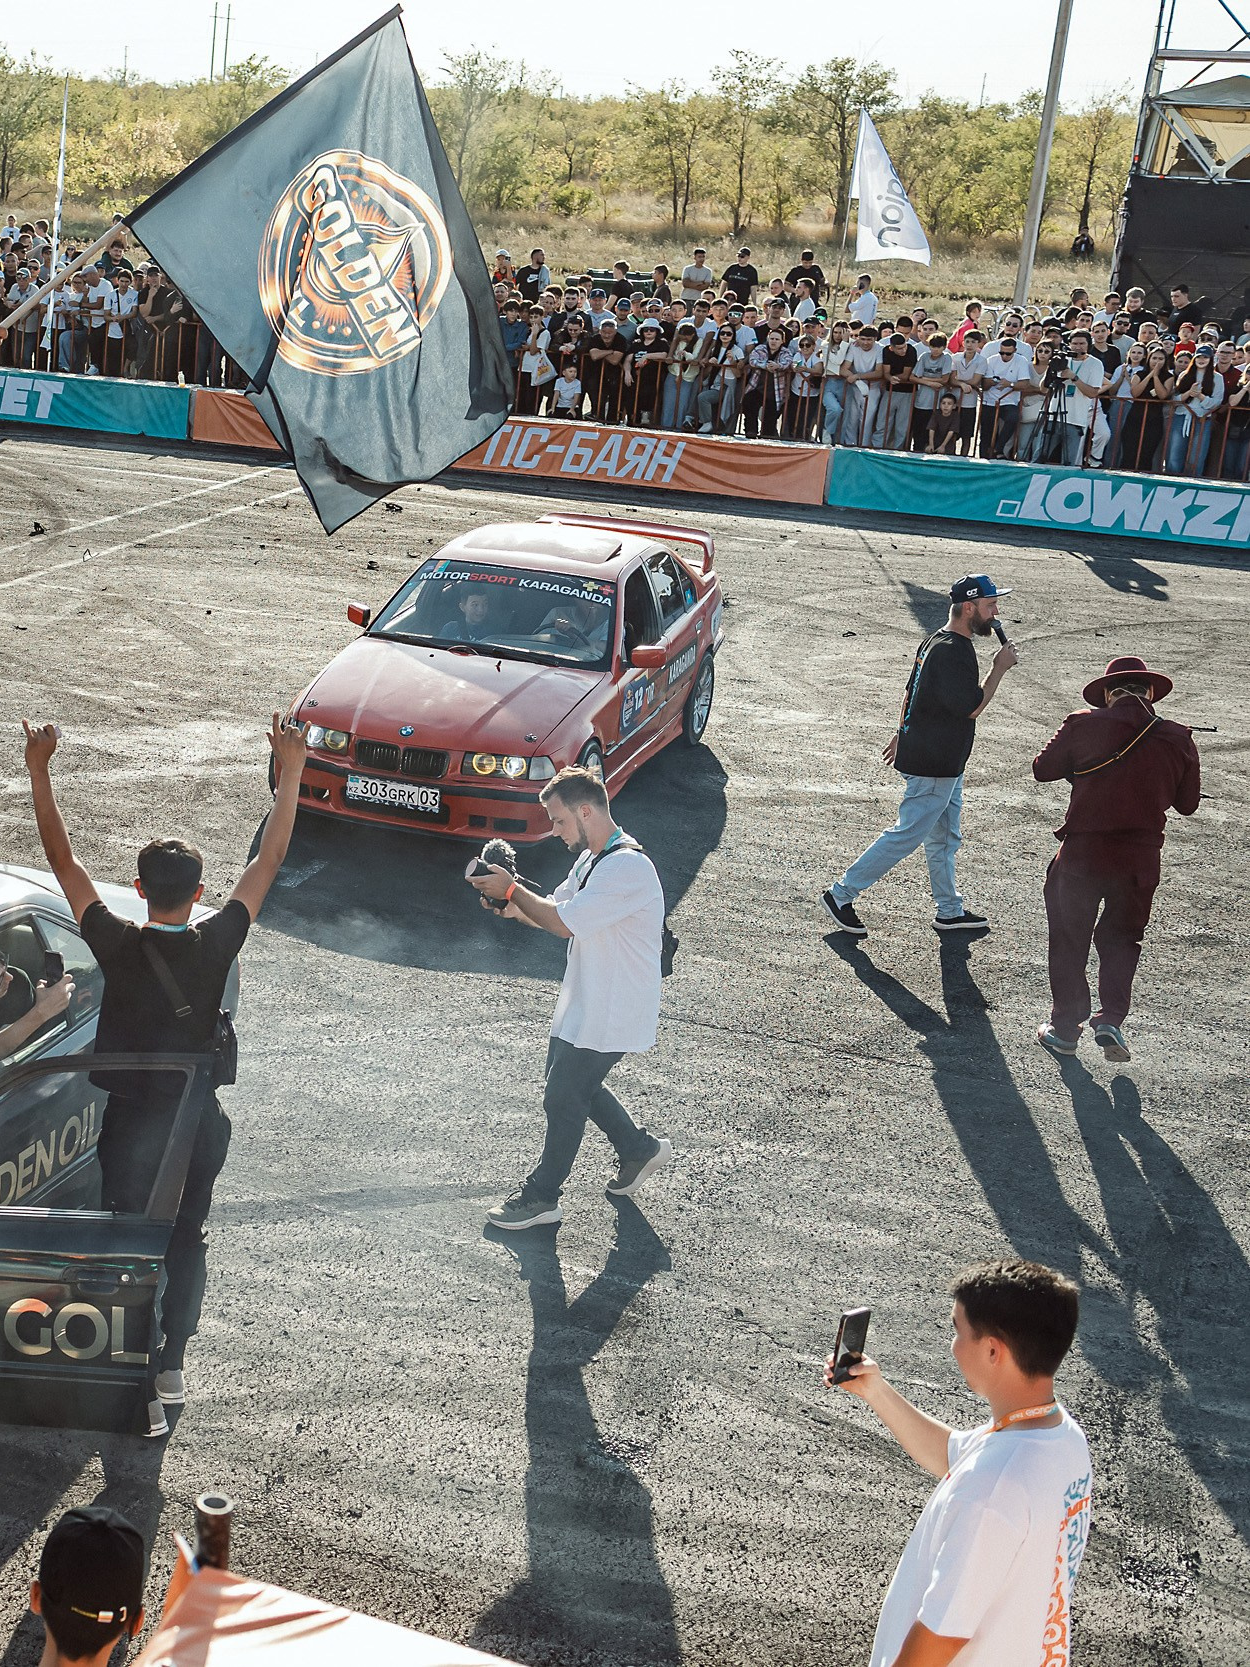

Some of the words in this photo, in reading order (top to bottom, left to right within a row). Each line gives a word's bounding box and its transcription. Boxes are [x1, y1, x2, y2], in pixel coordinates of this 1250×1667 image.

[301, 166, 420, 356] GOLDEN
[518, 578, 613, 607] KARAGANDA
[348, 786, 359, 794] KZ
[420, 790, 439, 807] 03
[3, 1297, 149, 1364] GOL
